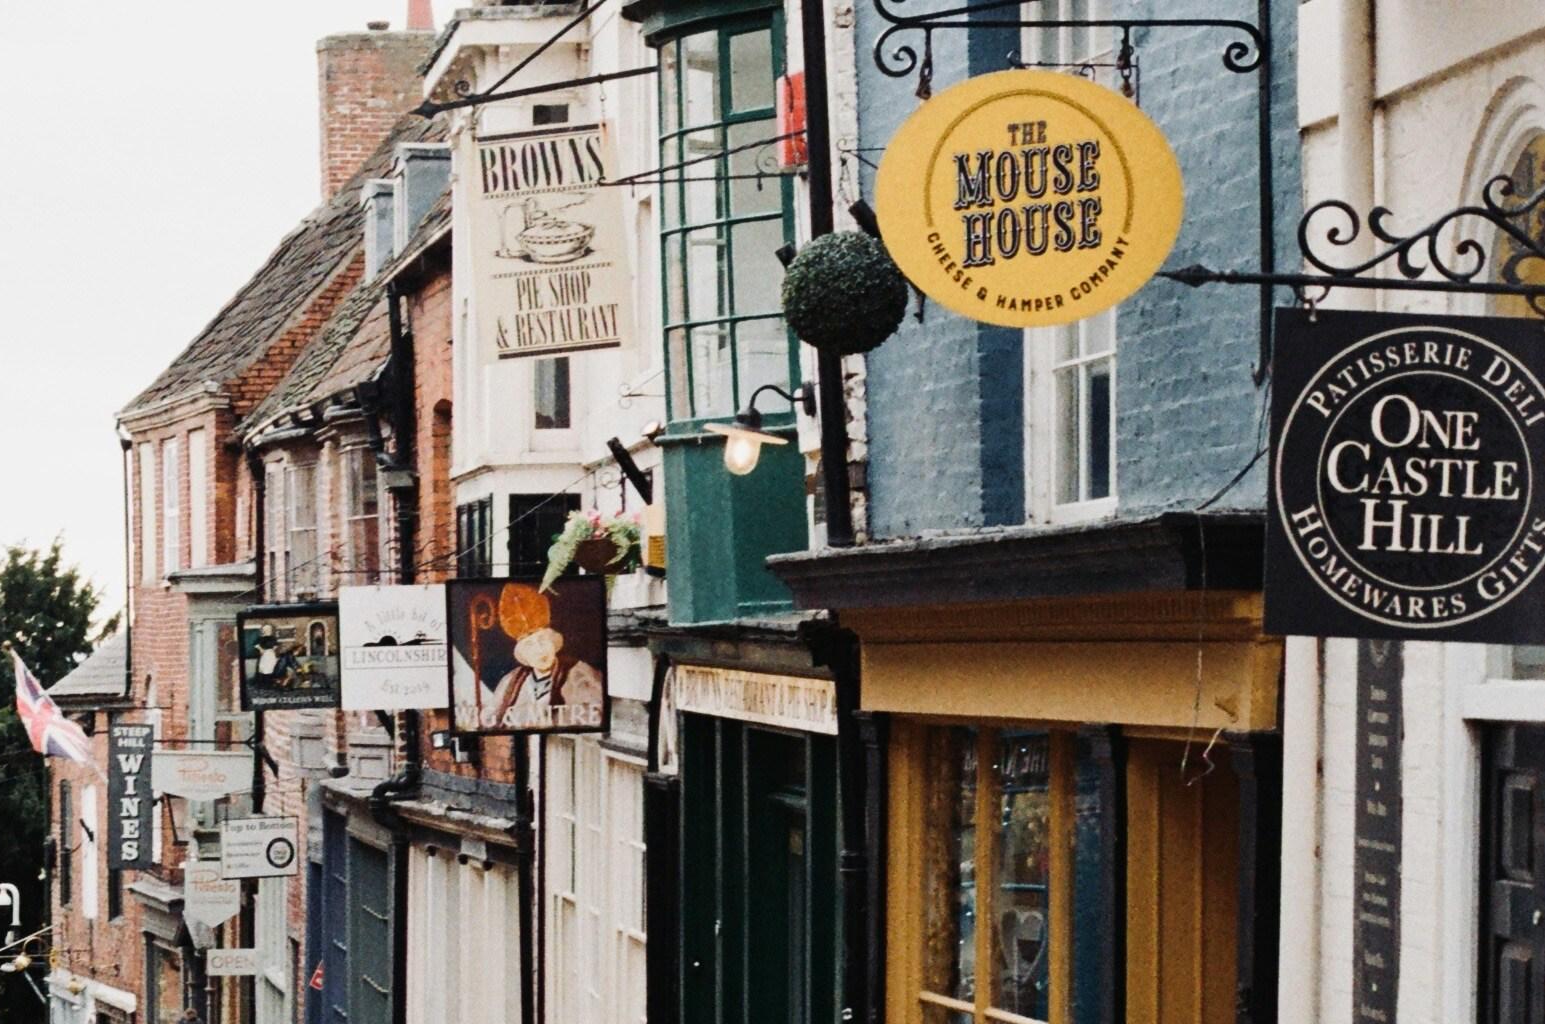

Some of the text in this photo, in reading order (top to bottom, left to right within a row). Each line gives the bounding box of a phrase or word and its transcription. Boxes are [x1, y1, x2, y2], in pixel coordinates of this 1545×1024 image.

[1007, 120, 1047, 146] THE
[479, 136, 607, 194] BROWNS
[953, 139, 1101, 210] MOUSE
[962, 196, 1103, 268] HOUSE
[516, 271, 591, 311] PIE SHOP
[927, 231, 1130, 313] CHEESE & HAMPER COMPANY
[496, 303, 619, 350] & RESTAURANT
[1306, 342, 1545, 427] PATISSERIE DELI
[1370, 394, 1481, 451] ONE
[1327, 440, 1520, 500] CASTLE
[1357, 497, 1484, 556] HILL
[1291, 504, 1545, 618] HOMEWARES GIFTS
[112, 726, 151, 737] STEEP
[117, 738, 146, 748] HILL
[117, 753, 145, 861] WINES
